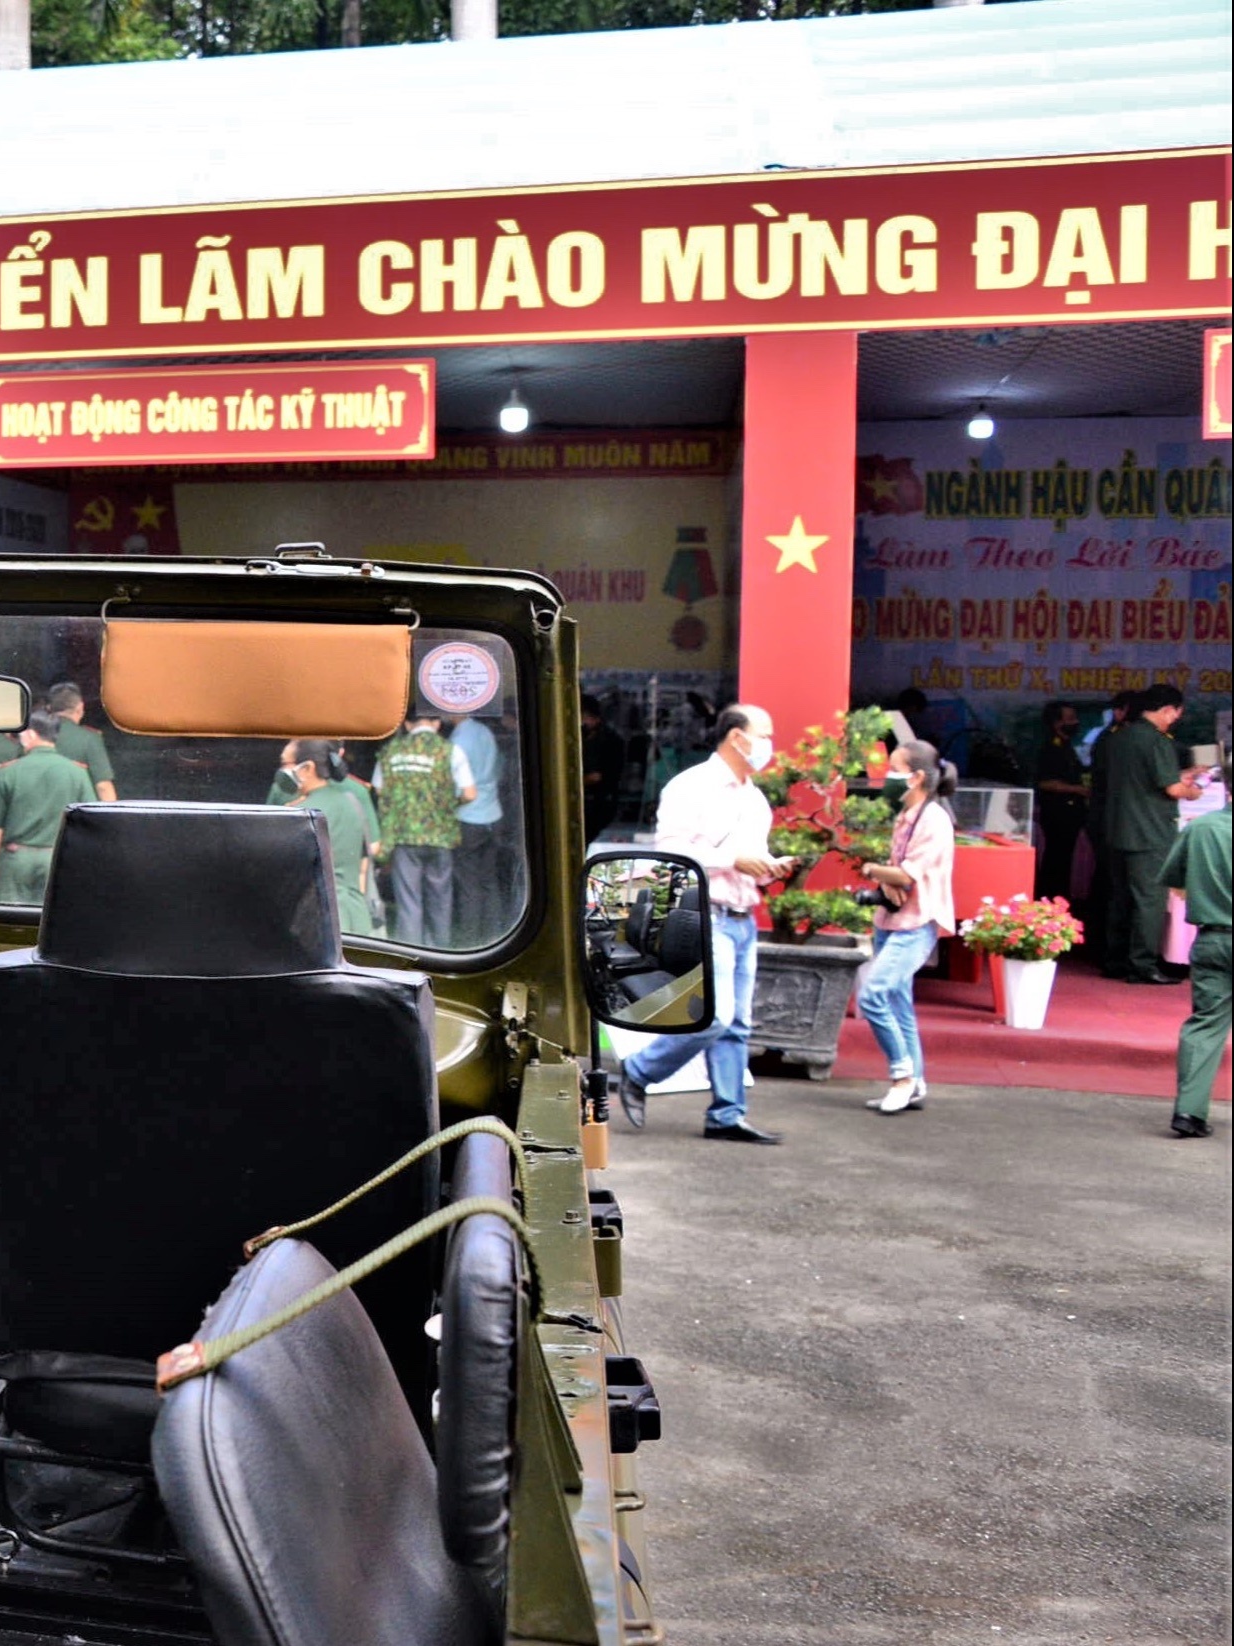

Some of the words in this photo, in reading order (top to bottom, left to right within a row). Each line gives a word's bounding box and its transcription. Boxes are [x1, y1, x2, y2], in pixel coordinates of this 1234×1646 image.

[139, 235, 325, 326] LÃM
[358, 219, 606, 316] CHÀO
[641, 203, 938, 304] MỪNG
[972, 204, 1149, 305] ĐẠI
[1188, 200, 1232, 281] H
[1, 402, 66, 444] HOẠT
[70, 393, 142, 442] ĐỘNG
[147, 391, 218, 434] CÔNG
[224, 388, 275, 431] TÁC
[280, 387, 316, 430] KỸ
[321, 384, 407, 436] THUẬT
[496, 444, 556, 469] VINH
[564, 440, 642, 468] MUÔN
[925, 457, 1028, 520] NGÀNH
[1030, 458, 1091, 533] HẬU
[1164, 457, 1232, 525] QUÂ
[1192, 581, 1232, 643] ĐẢ
